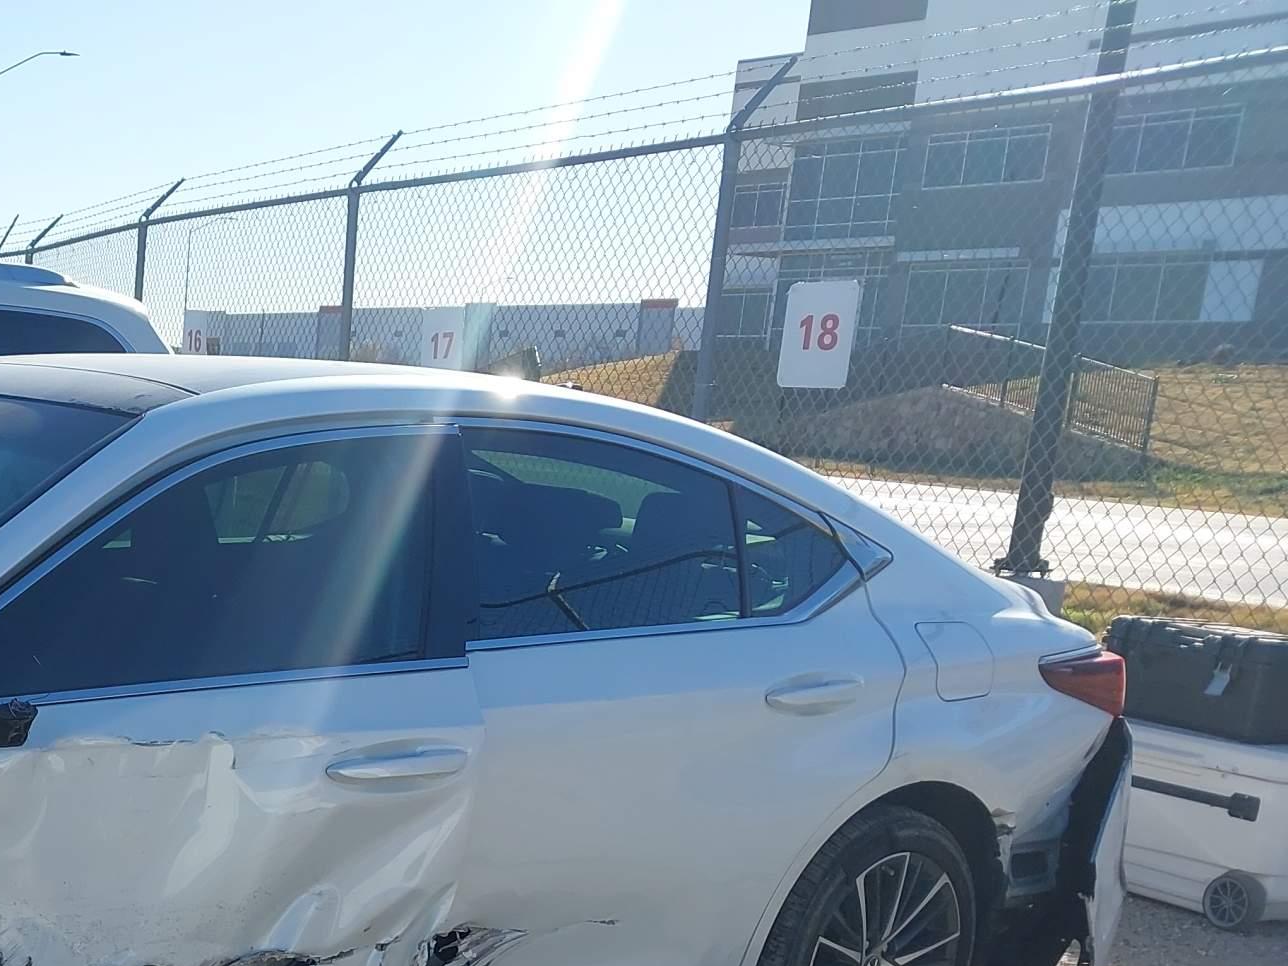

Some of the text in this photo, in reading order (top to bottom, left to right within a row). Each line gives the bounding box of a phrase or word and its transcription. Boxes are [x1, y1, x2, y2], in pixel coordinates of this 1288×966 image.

[188, 328, 202, 353] 16
[431, 331, 454, 360] 17
[799, 313, 840, 351] 18
